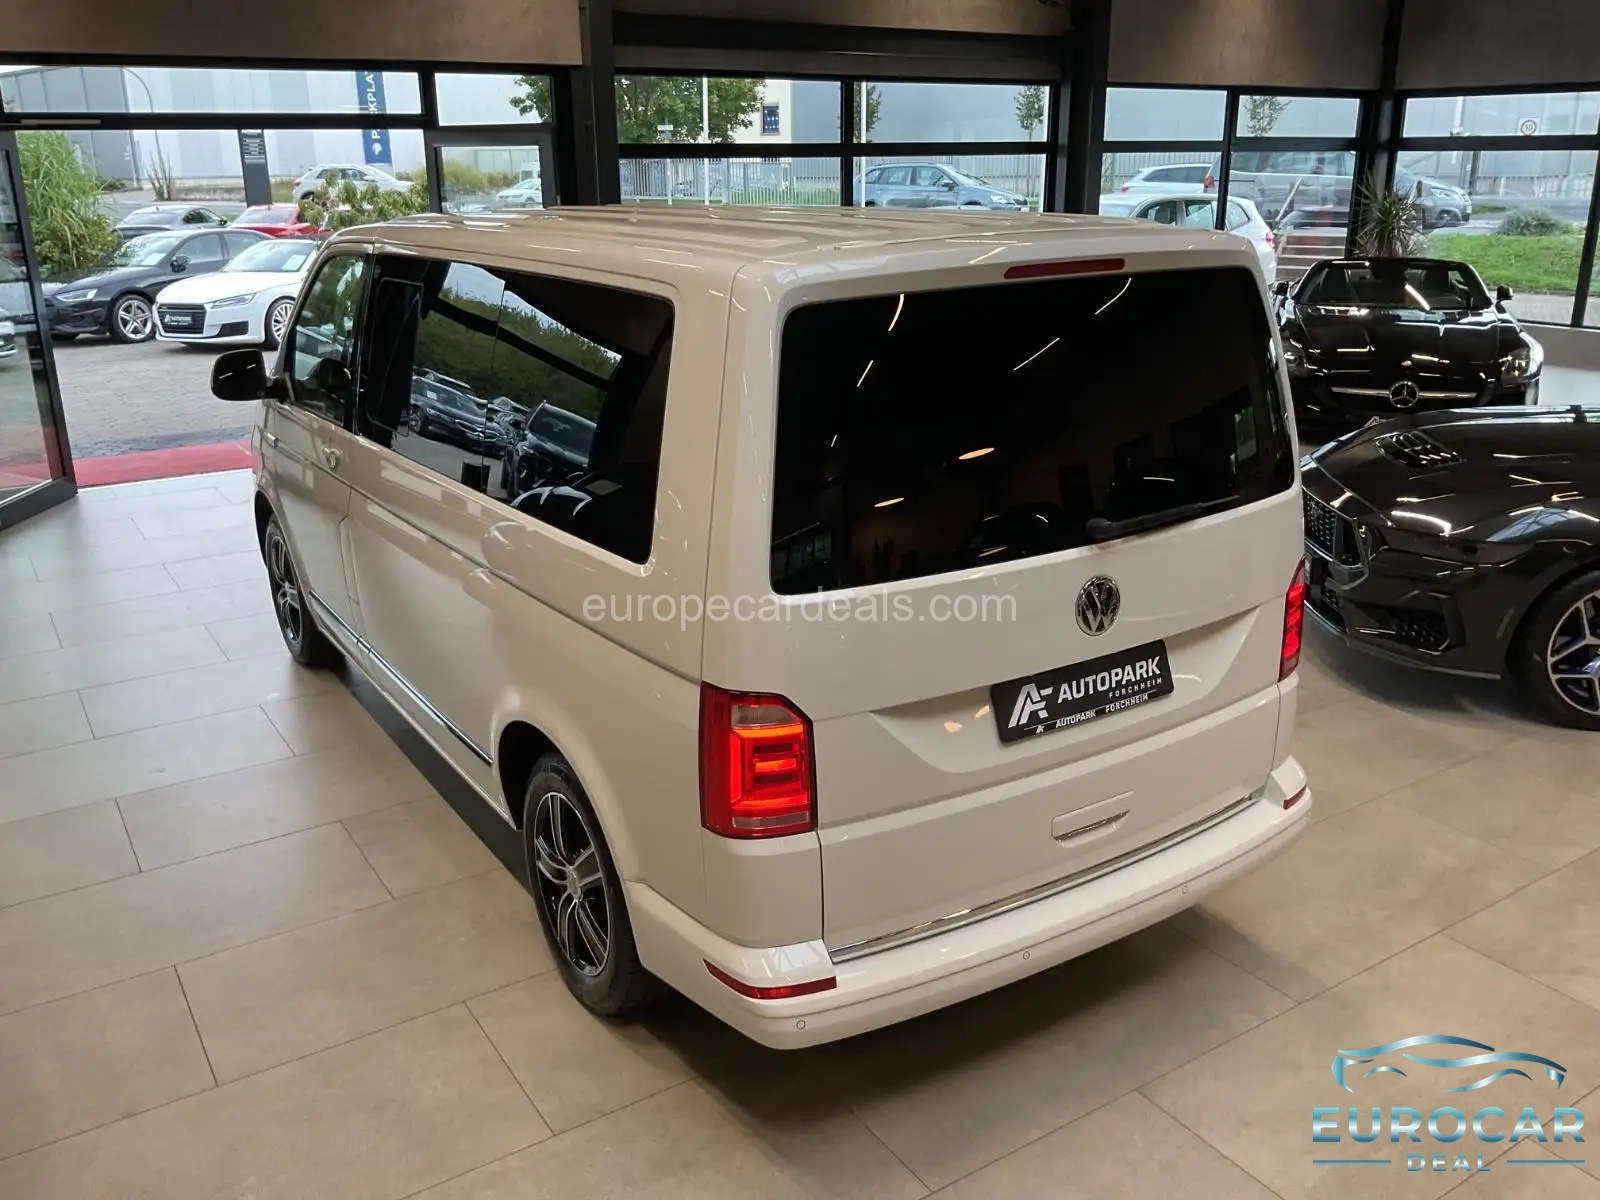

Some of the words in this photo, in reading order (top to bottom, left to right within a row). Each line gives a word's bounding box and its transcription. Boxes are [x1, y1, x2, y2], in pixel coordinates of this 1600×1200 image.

[1057, 656, 1161, 703] AUTOPARK
[1108, 677, 1162, 699] FORCHHEIM
[1056, 710, 1096, 728] AUTOPARK
[1105, 694, 1148, 712] FORCHHEIM
